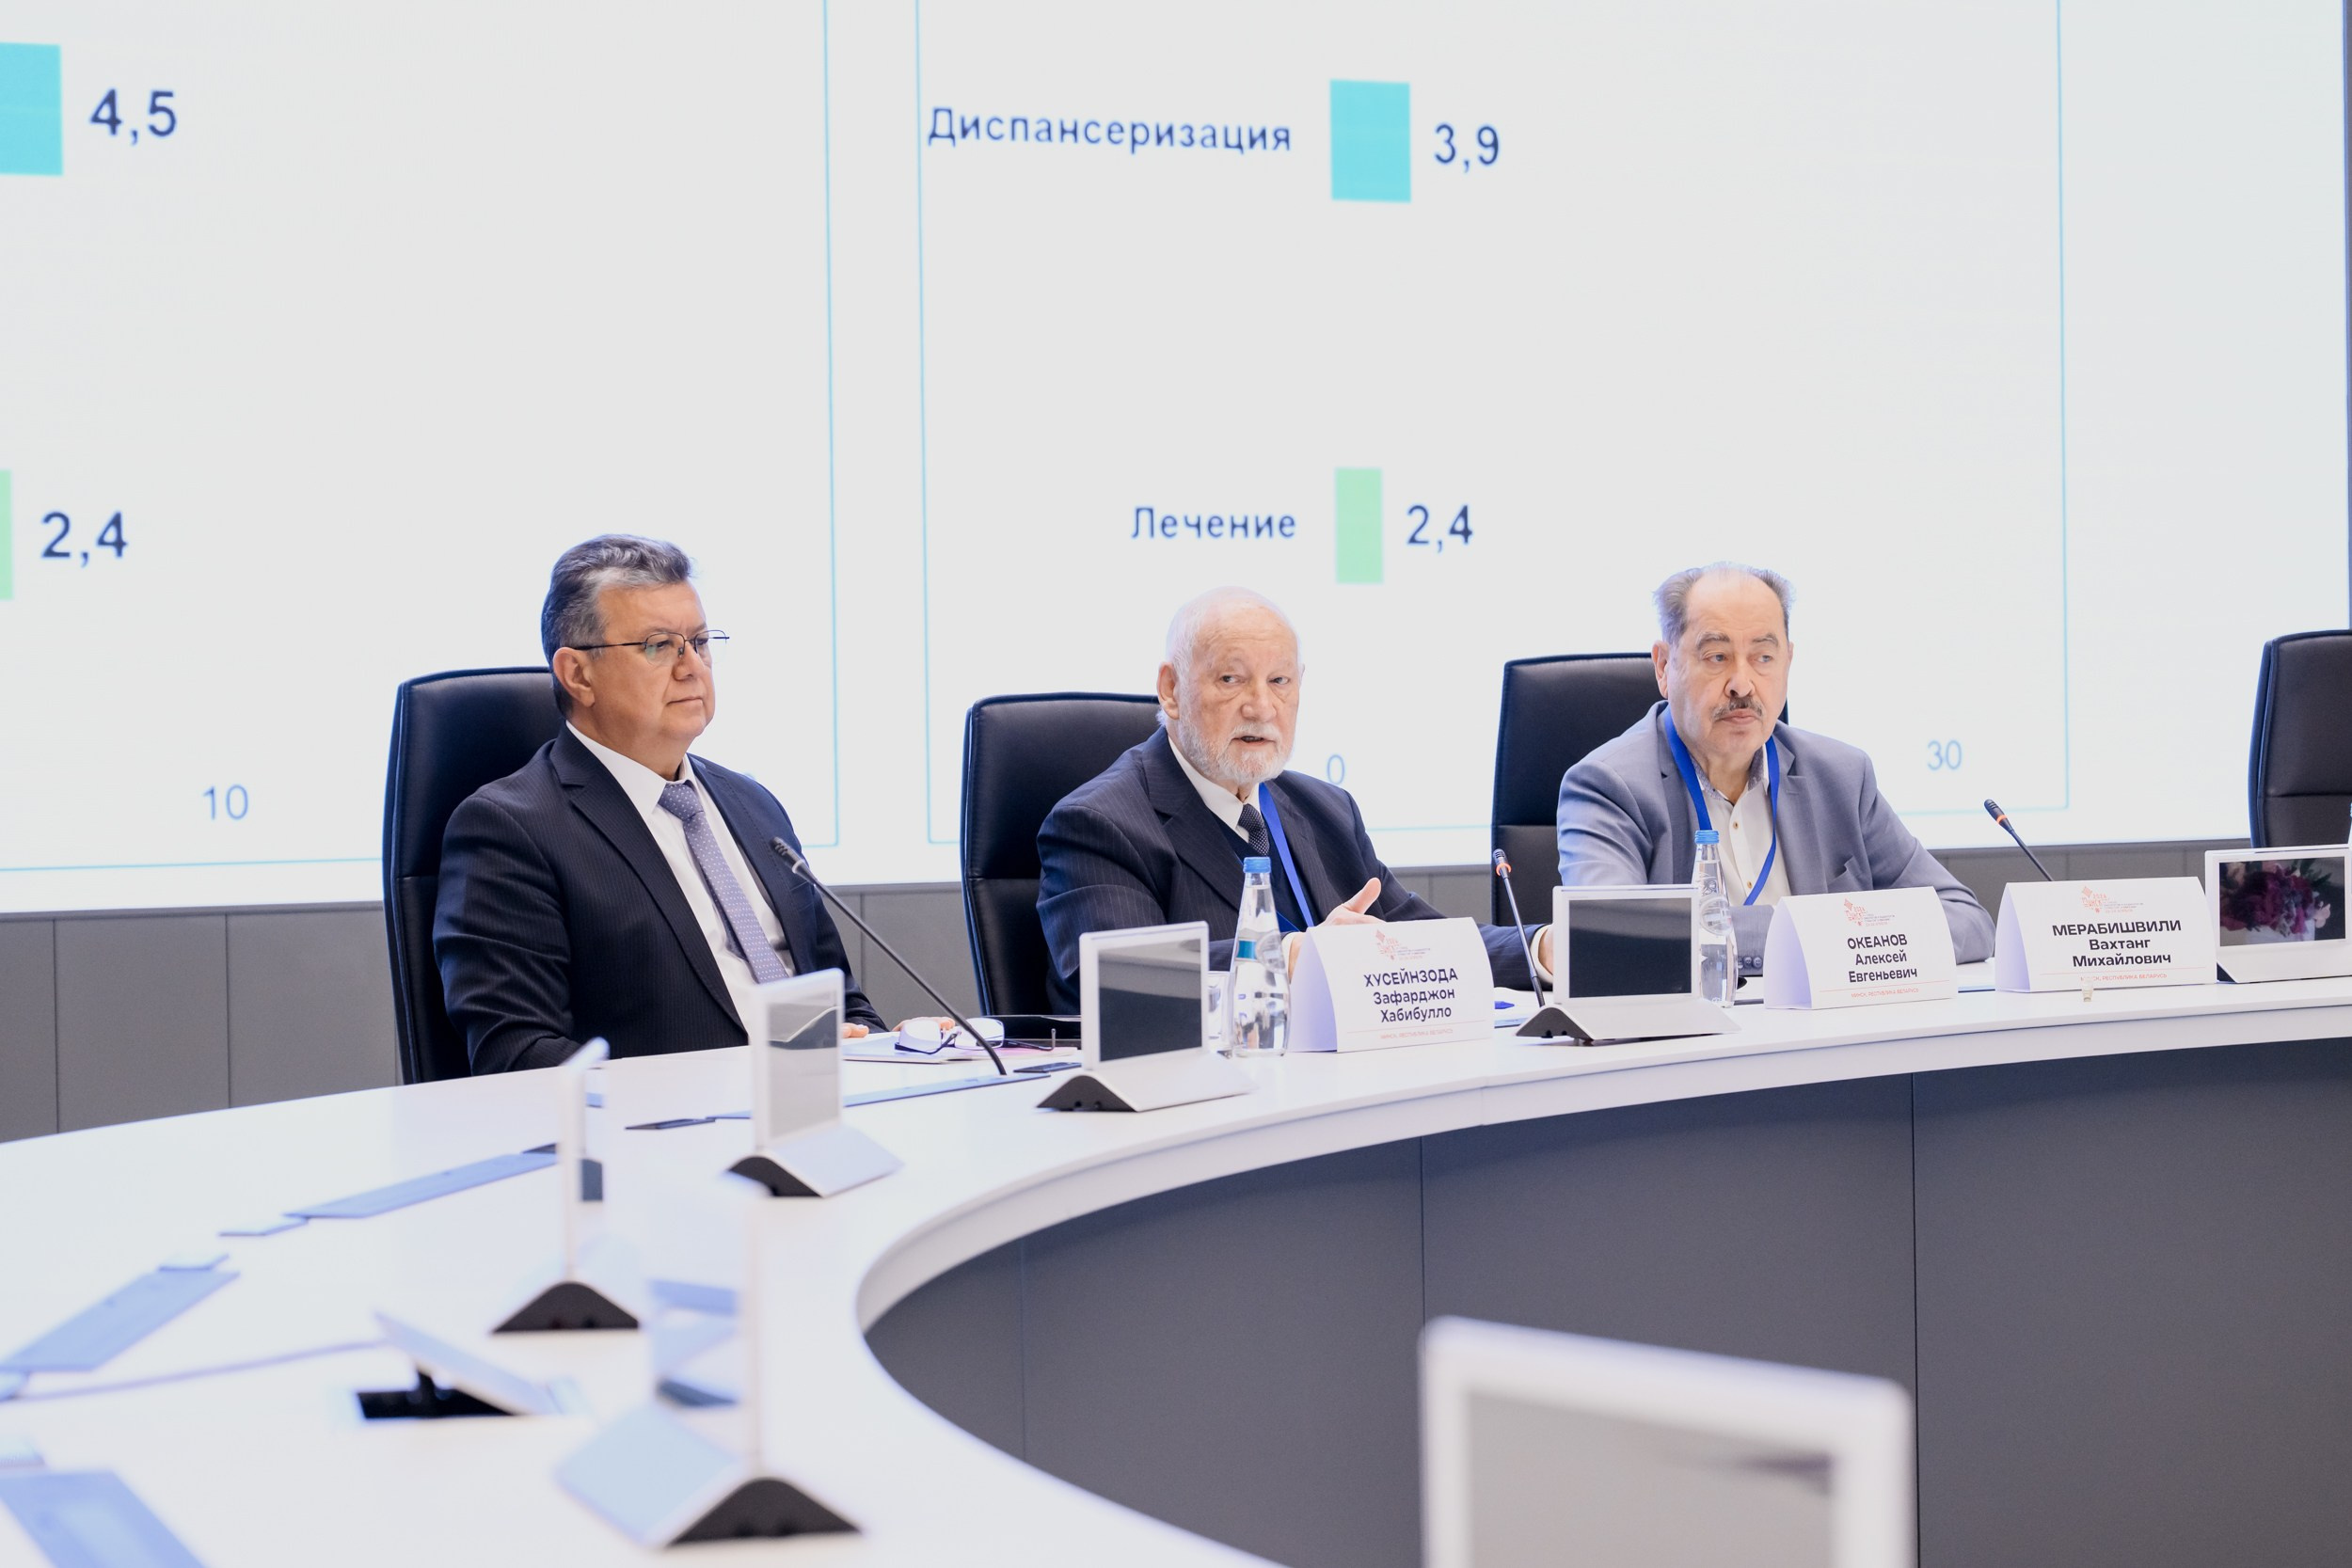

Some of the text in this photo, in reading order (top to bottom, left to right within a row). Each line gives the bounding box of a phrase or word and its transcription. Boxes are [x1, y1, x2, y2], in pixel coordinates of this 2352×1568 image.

[88, 87, 179, 147] 4,5
[927, 105, 1292, 155] Диспансеризация
[1434, 121, 1502, 174] 3,9
[1131, 504, 1297, 540] Лечение
[1406, 503, 1474, 554] 2,4
[40, 510, 130, 569] 2,4
[1927, 739, 1963, 771] 30
[1327, 754, 1345, 784] 0
[201, 784, 250, 821] 10
[2052, 919, 2182, 937] МЕРАБИШВИЛИ
[1847, 933, 1908, 950] ОКЕАНОВ
[2089, 939, 2151, 951] Вахтанг
[1855, 949, 1907, 965] Алексей
[2072, 952, 2171, 967] Михайлович
[1364, 967, 1458, 988] ХУСЕЙНЗОДА
[1848, 968, 1917, 983] Евгеньевич
[1374, 988, 1455, 1006] Зафарджон
[1381, 1006, 1452, 1023] Хабибулло
